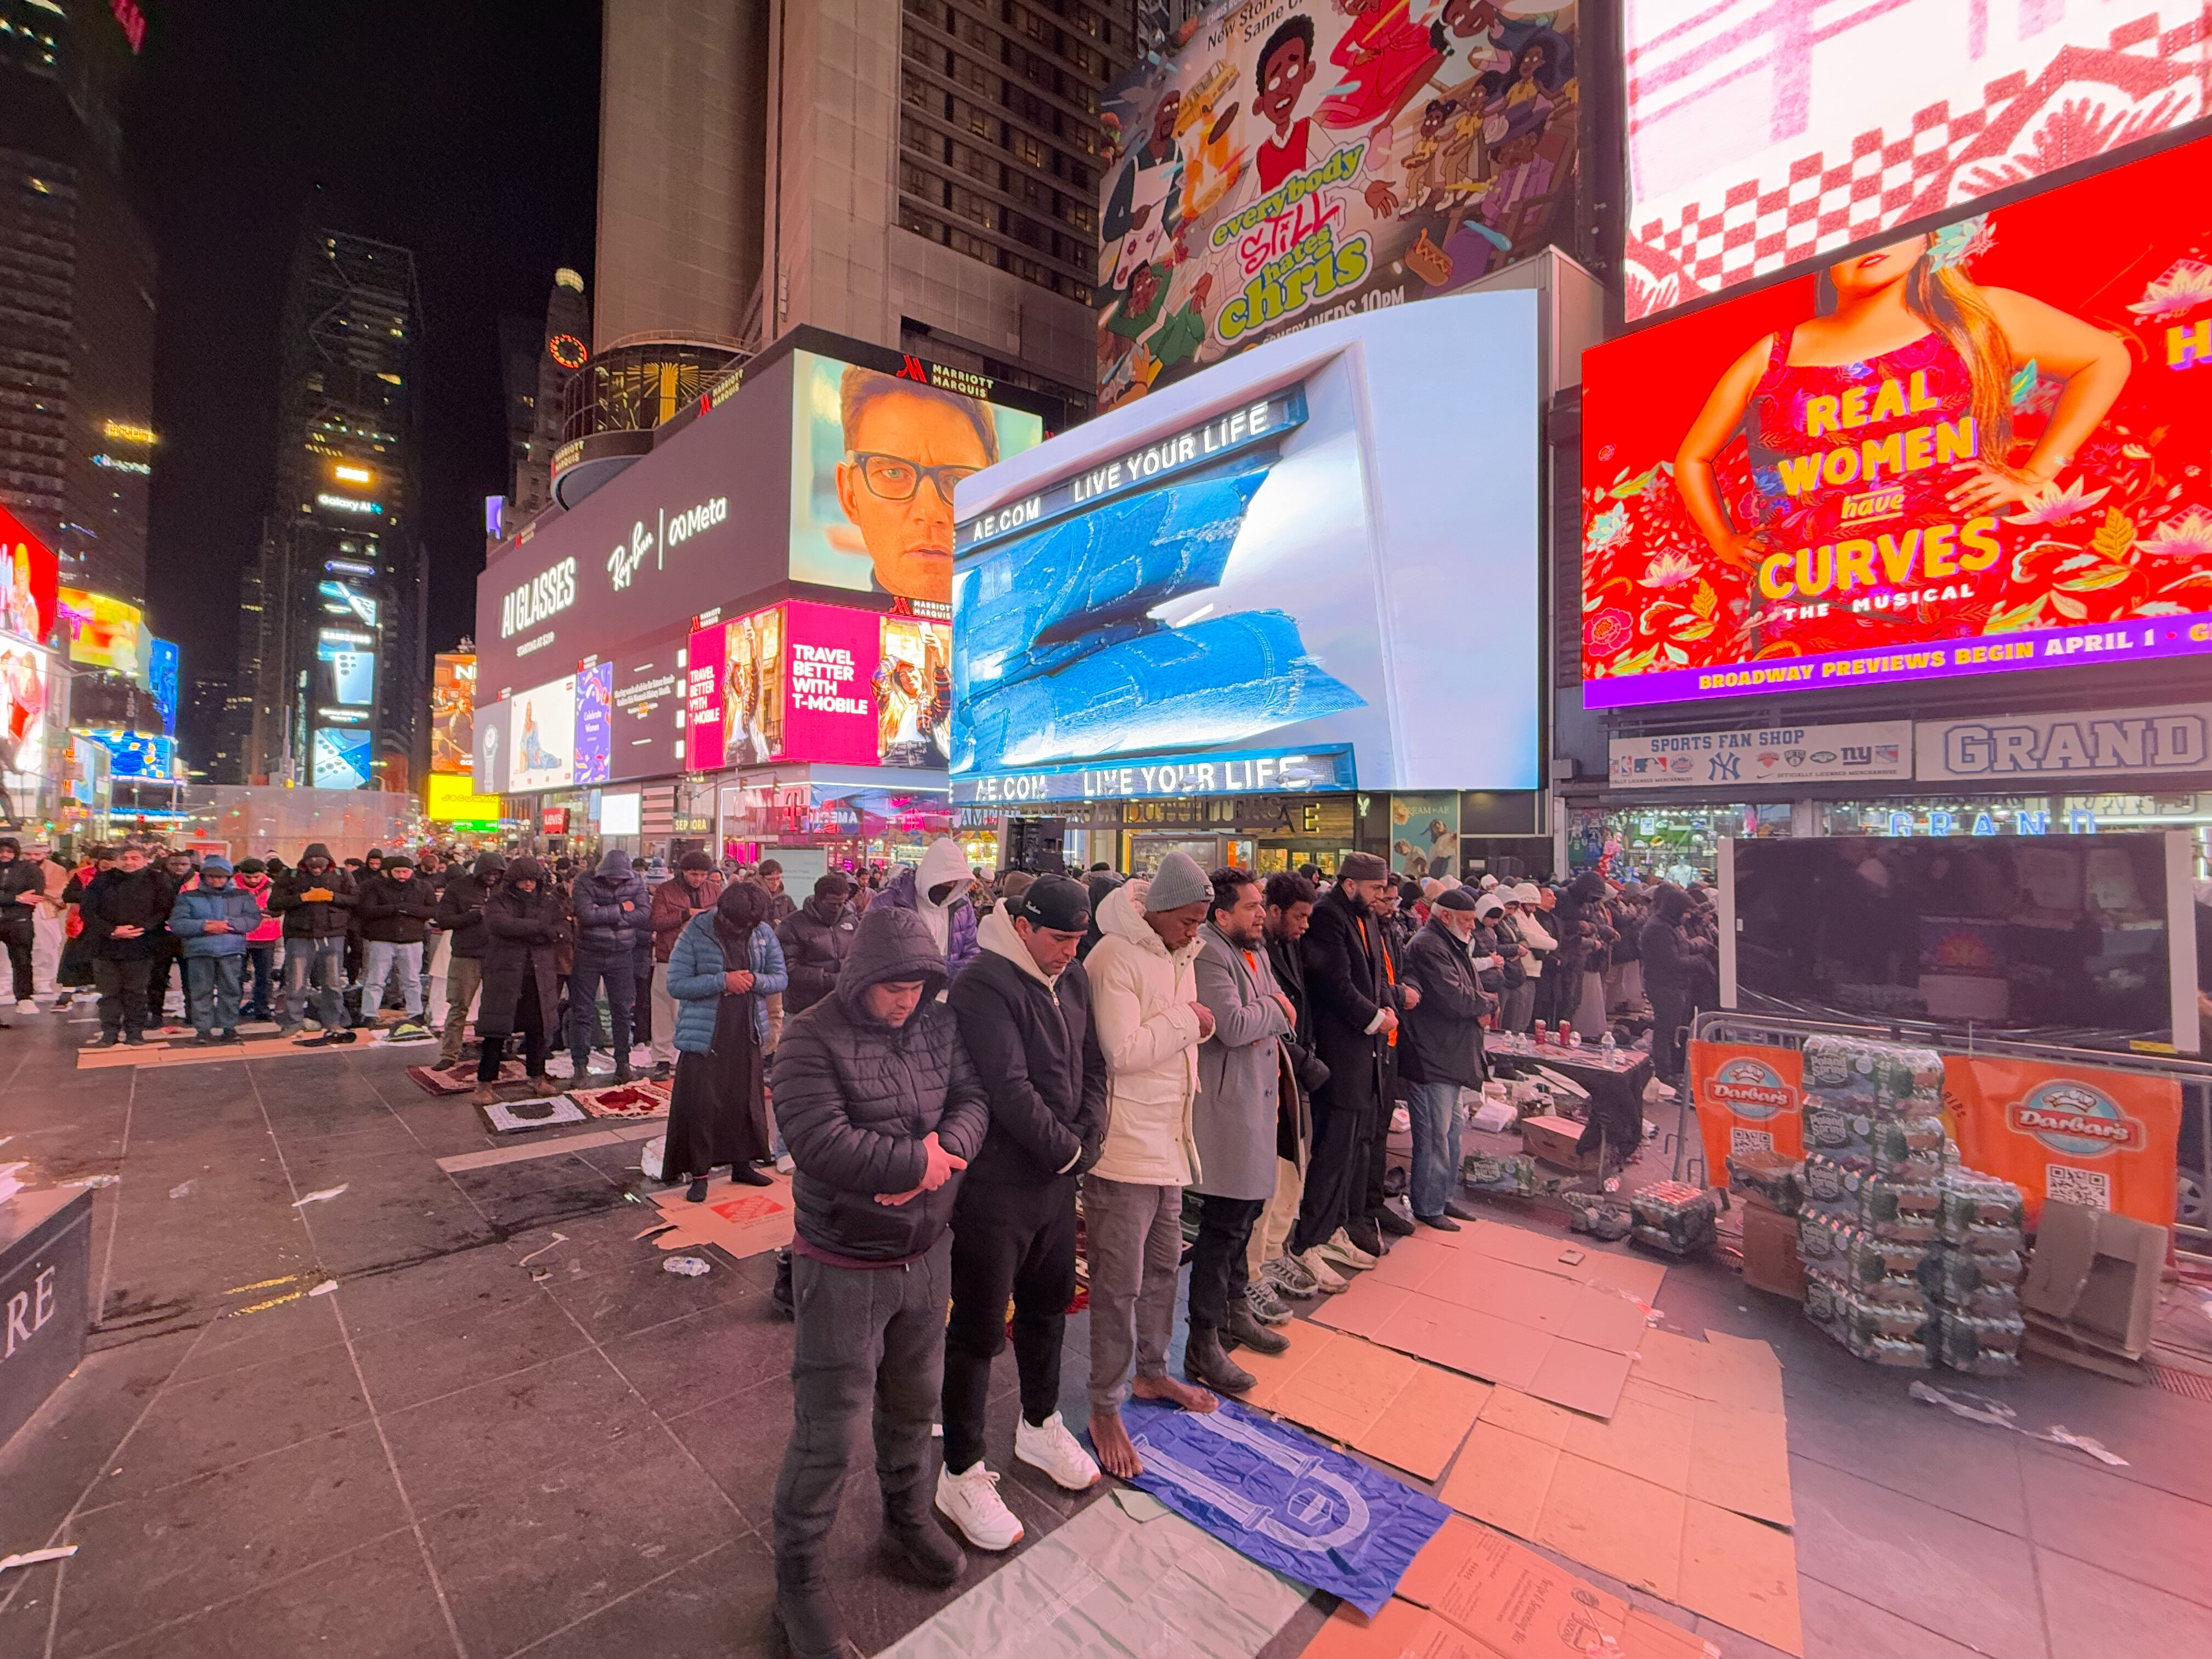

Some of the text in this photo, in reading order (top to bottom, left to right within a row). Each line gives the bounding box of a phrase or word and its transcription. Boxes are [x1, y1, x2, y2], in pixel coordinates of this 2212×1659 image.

[1207, 21, 1235, 51] New
[1244, 5, 1284, 43] Same
[1212, 144, 1365, 246] everybody
[1261, 224, 1333, 286] hates
[1218, 237, 1368, 341] chris
[713, 369, 744, 396] MARRIOTT
[933, 364, 994, 389] MARRIOTT
[933, 375, 987, 398] MARQUIS
[713, 382, 740, 408] MARQUIS
[1806, 370, 1940, 437] REAL
[1778, 416, 1978, 496] WOMEN
[973, 402, 1270, 541] AE.COM LIVE YOUR LIFE
[318, 494, 359, 512] Galaxy
[1841, 495, 1905, 520] have
[687, 496, 728, 538] Meta
[1758, 517, 2001, 600] CURVES
[501, 556, 576, 639] AI GLASSES
[1782, 583, 1975, 622] THE MUSICAL
[913, 608, 951, 619] MARQUIS
[323, 631, 370, 645] SAMSUNG
[793, 644, 855, 665] TRAVEL
[1699, 664, 1814, 690] BROADWAY
[1821, 651, 1946, 679] PREVIEWS
[1955, 642, 2034, 665] BEGIN
[2043, 630, 2134, 657] APRIL
[2144, 629, 2155, 646] 1
[690, 665, 715, 682] TRAVEL
[793, 661, 854, 681] BETTER
[690, 679, 714, 698] BETTER
[792, 676, 837, 696] WITH
[583, 710, 602, 721] Celebrate
[792, 693, 868, 715] T-MOBILE
[585, 724, 600, 733] Women
[1651, 729, 1805, 752] SPORTS FAN SHOP
[1944, 715, 2208, 775] GRAND
[975, 755, 1308, 802] AE.COM LIVE YOUR LIFE
[675, 818, 707, 832] SEPORA
[1889, 809, 2096, 838] GRAND
[1810, 1054, 1847, 1070] Poland
[1812, 1065, 1848, 1080] Spring
[1714, 1084, 1788, 1105] Darbar's
[2019, 1109, 2130, 1141] Darbar's
